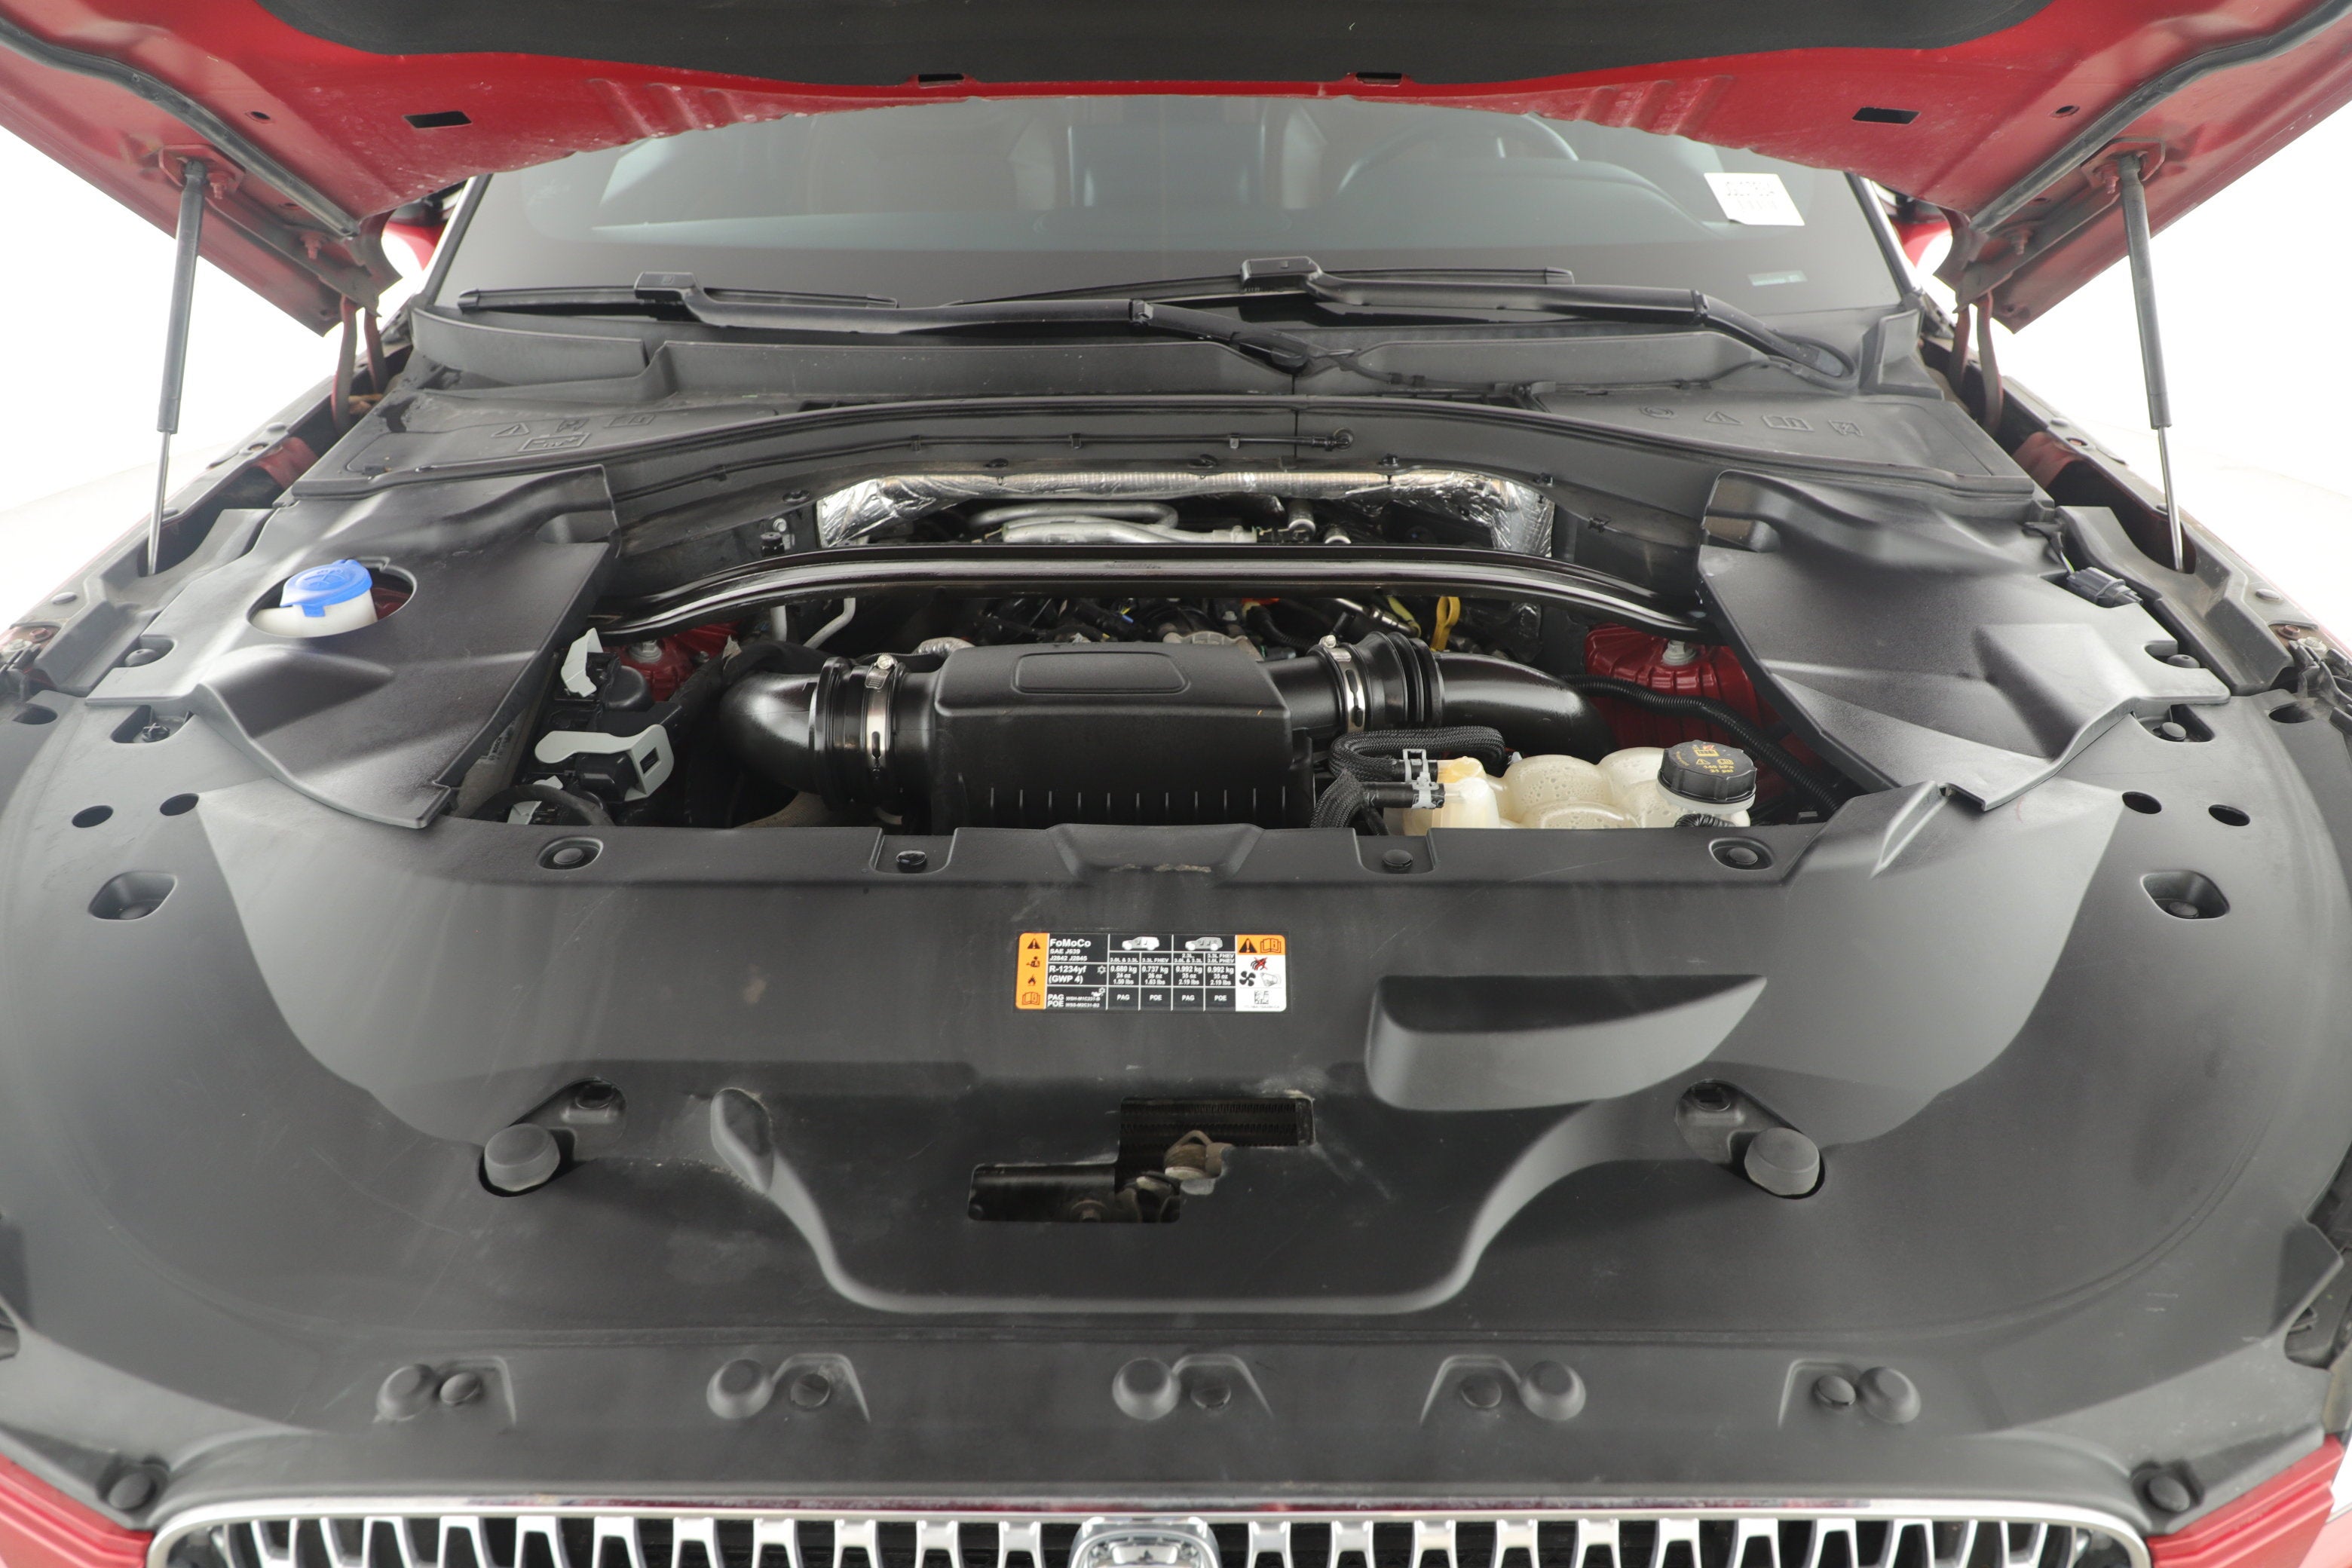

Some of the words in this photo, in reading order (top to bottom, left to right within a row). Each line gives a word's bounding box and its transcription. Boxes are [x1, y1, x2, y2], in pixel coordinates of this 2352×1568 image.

[1049, 939, 1092, 948] FoMoCo
[1049, 965, 1087, 975] R-1234yf
[1129, 966, 1138, 974] kg
[1160, 966, 1168, 974] kg
[1194, 966, 1202, 974] kg
[1049, 975, 1073, 984] (GWP
[1074, 975, 1083, 984] 4)
